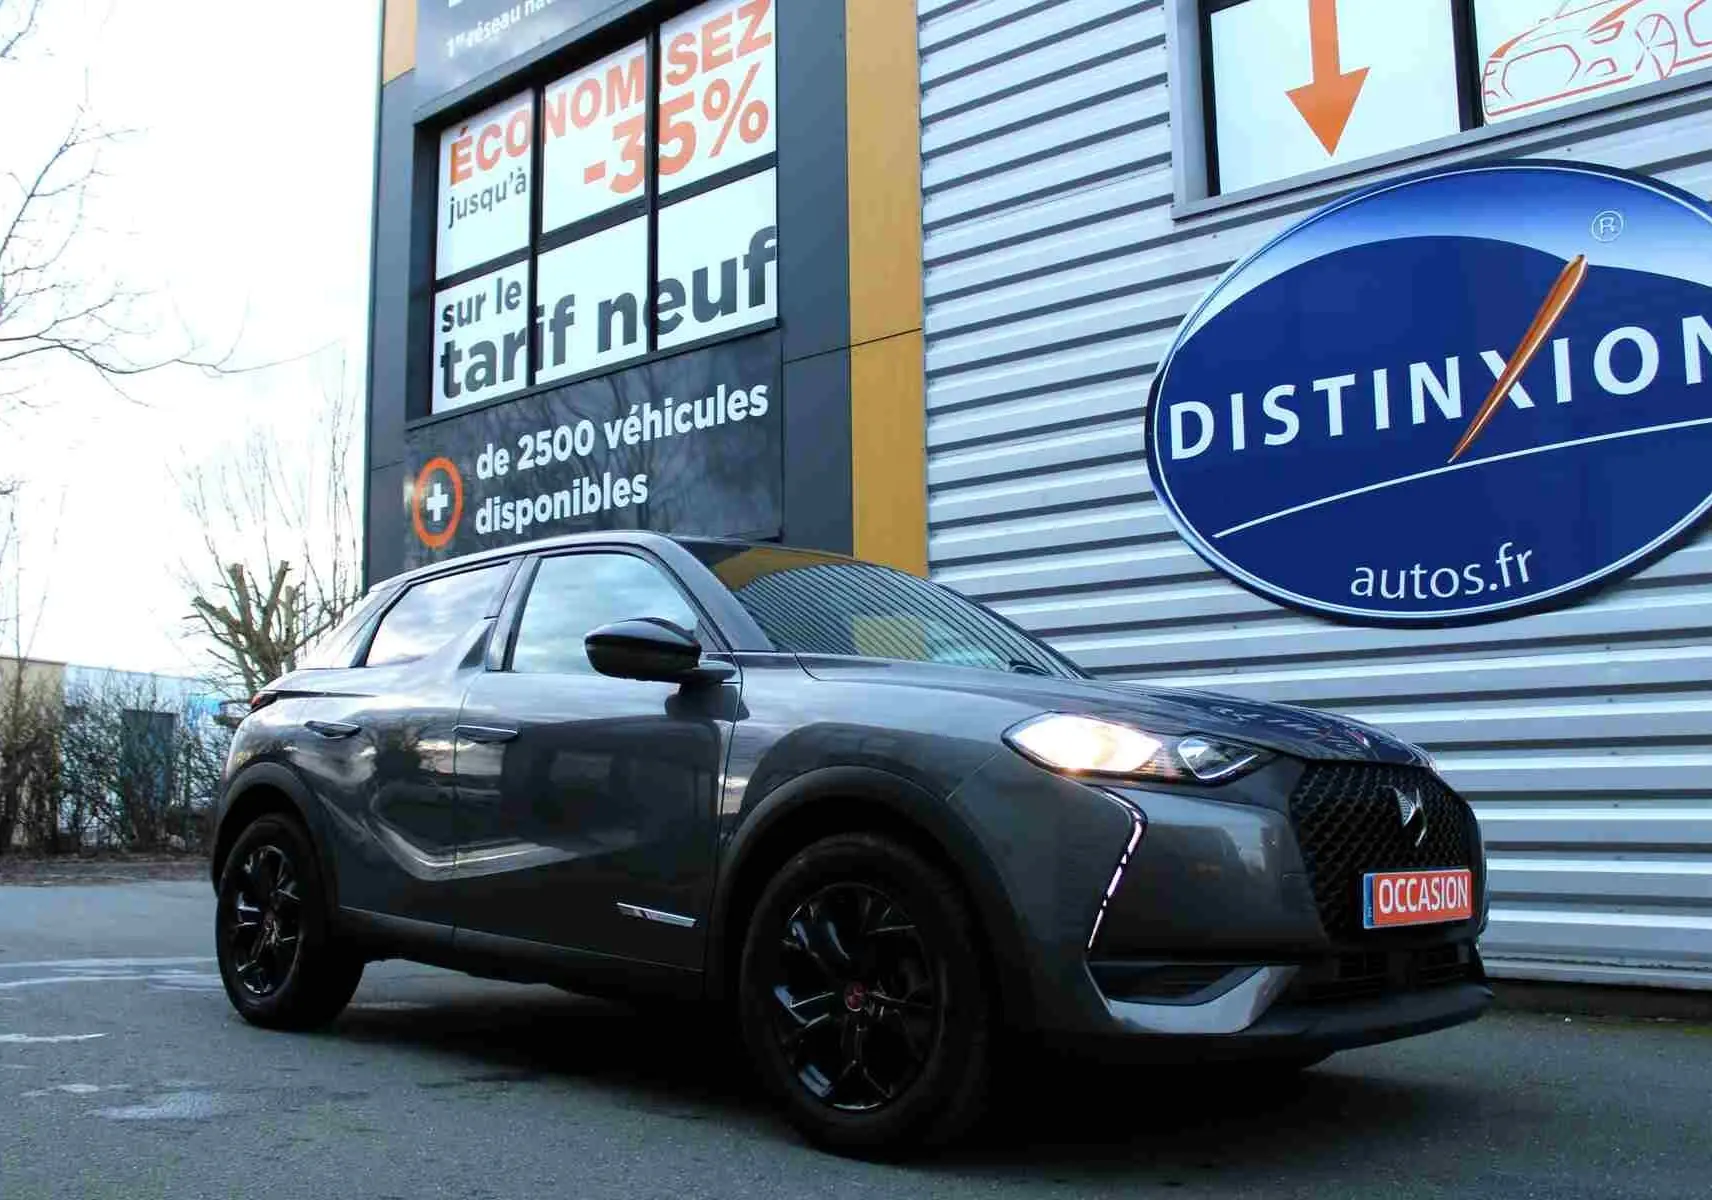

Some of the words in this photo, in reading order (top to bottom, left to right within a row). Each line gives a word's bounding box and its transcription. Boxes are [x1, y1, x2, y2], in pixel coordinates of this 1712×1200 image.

[466, 4, 522, 48] réseau
[450, 0, 773, 187] ÉCONOMSEZ
[583, 61, 770, 194] -35%
[448, 166, 526, 229] jusqu'à
[440, 293, 576, 399] tarif
[597, 225, 778, 354] neuf
[441, 291, 487, 334] sur
[495, 277, 522, 315] le
[476, 443, 510, 480] de
[516, 420, 596, 472] 2500
[604, 383, 769, 450] véhicules
[475, 473, 650, 535] disponibles
[1350, 541, 1534, 600] autos.fr
[1378, 876, 1469, 914] OCCASION
